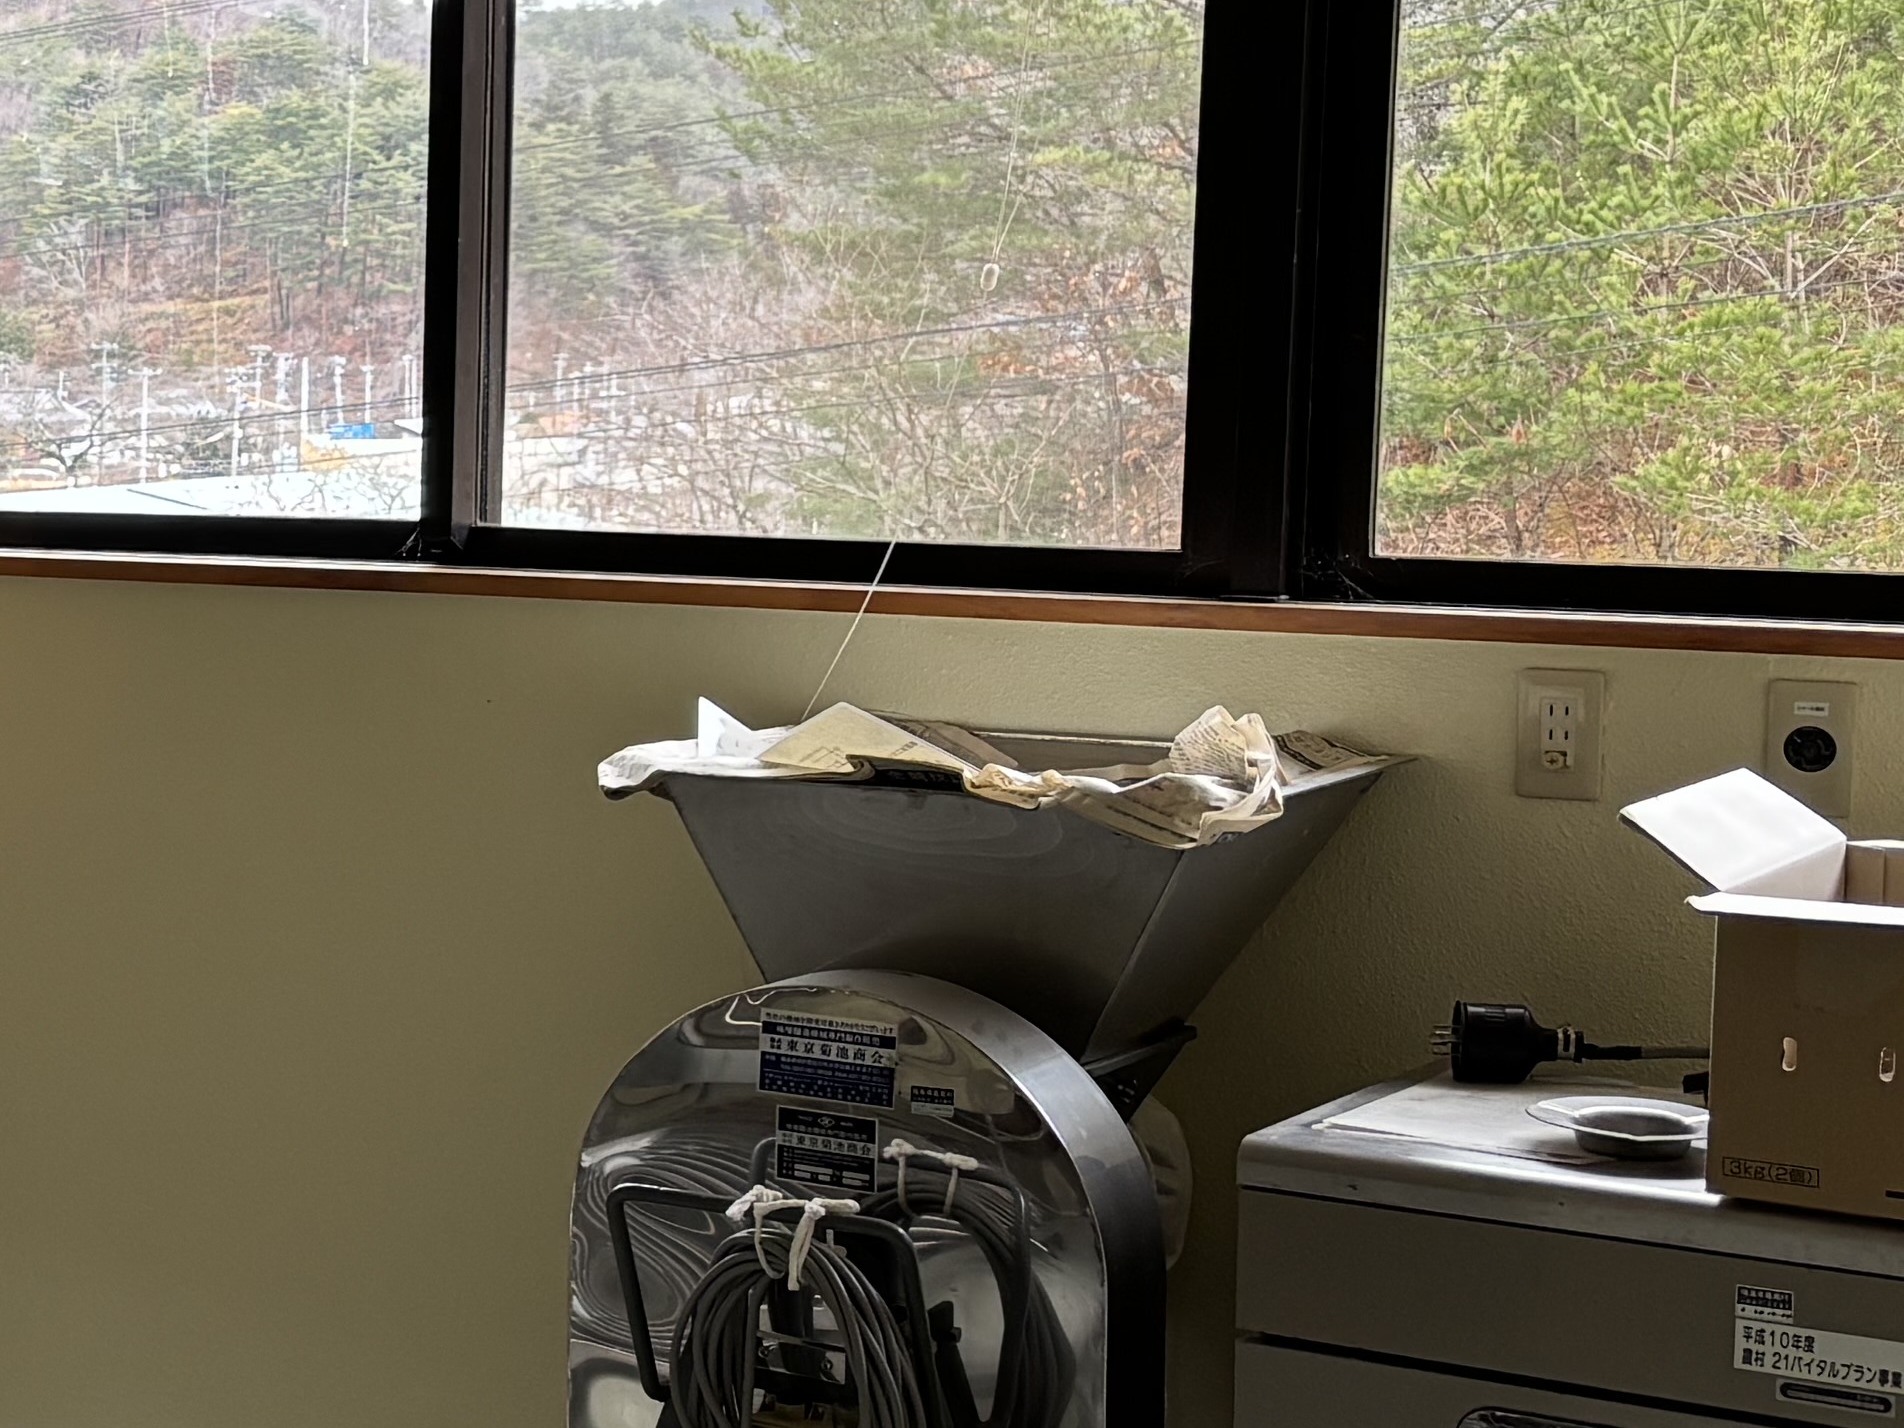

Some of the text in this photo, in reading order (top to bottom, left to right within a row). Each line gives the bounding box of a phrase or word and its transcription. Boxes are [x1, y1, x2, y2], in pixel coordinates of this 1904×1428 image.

[787, 1038, 885, 1065] 東京菊池商会
[1742, 1325, 1816, 1355] 平成10年度
[1771, 1351, 1904, 1390] 21バイタルプラン事業
